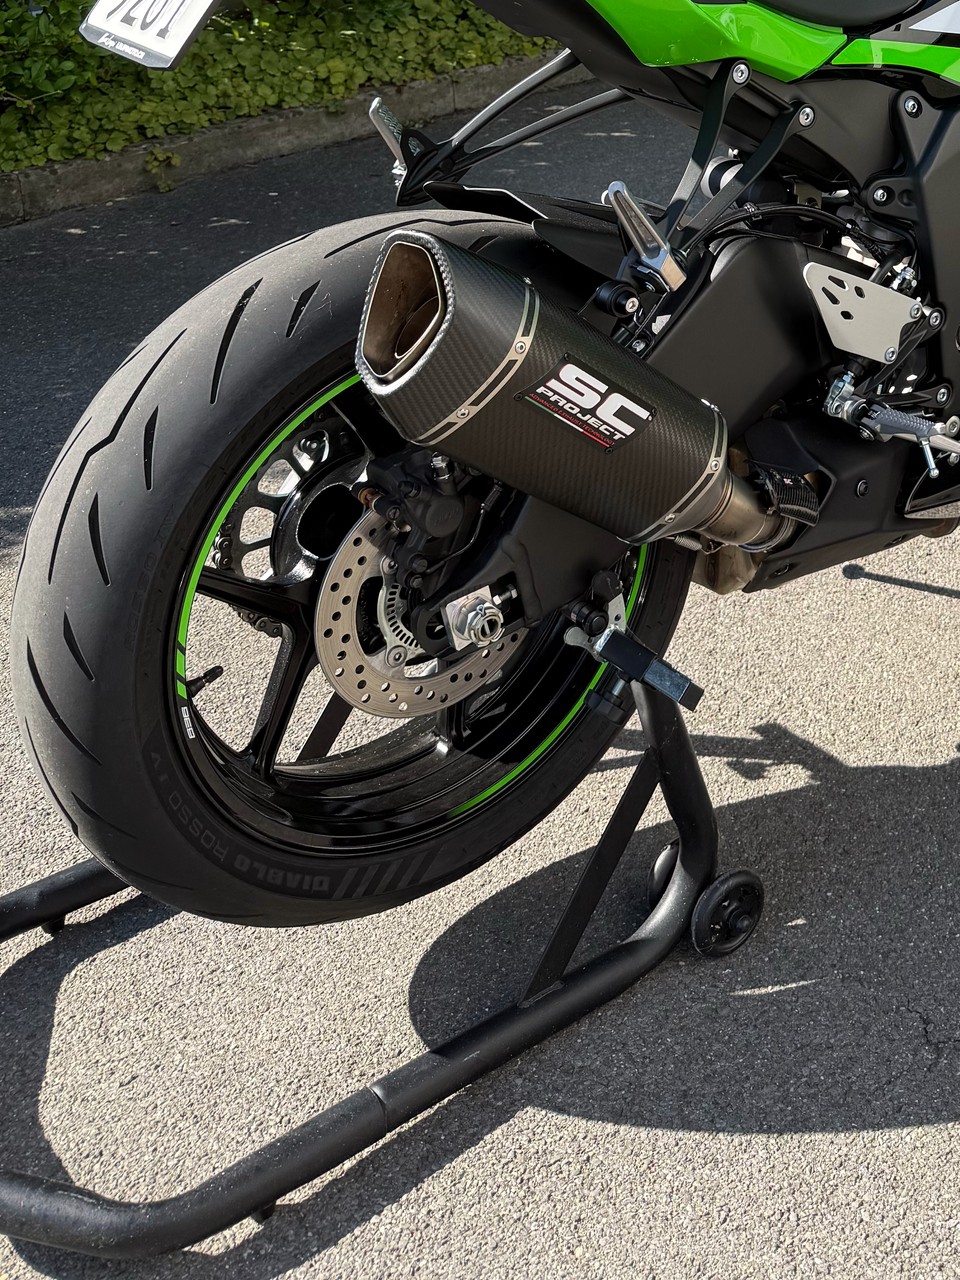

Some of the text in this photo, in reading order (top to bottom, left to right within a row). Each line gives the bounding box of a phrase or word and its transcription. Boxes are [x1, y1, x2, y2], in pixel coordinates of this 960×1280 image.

[535, 385, 626, 441] PROJECT
[545, 363, 651, 437] SC
[181, 706, 196, 740] 636
[168, 791, 231, 862] ROSSO
[233, 854, 332, 892] DIABLO
